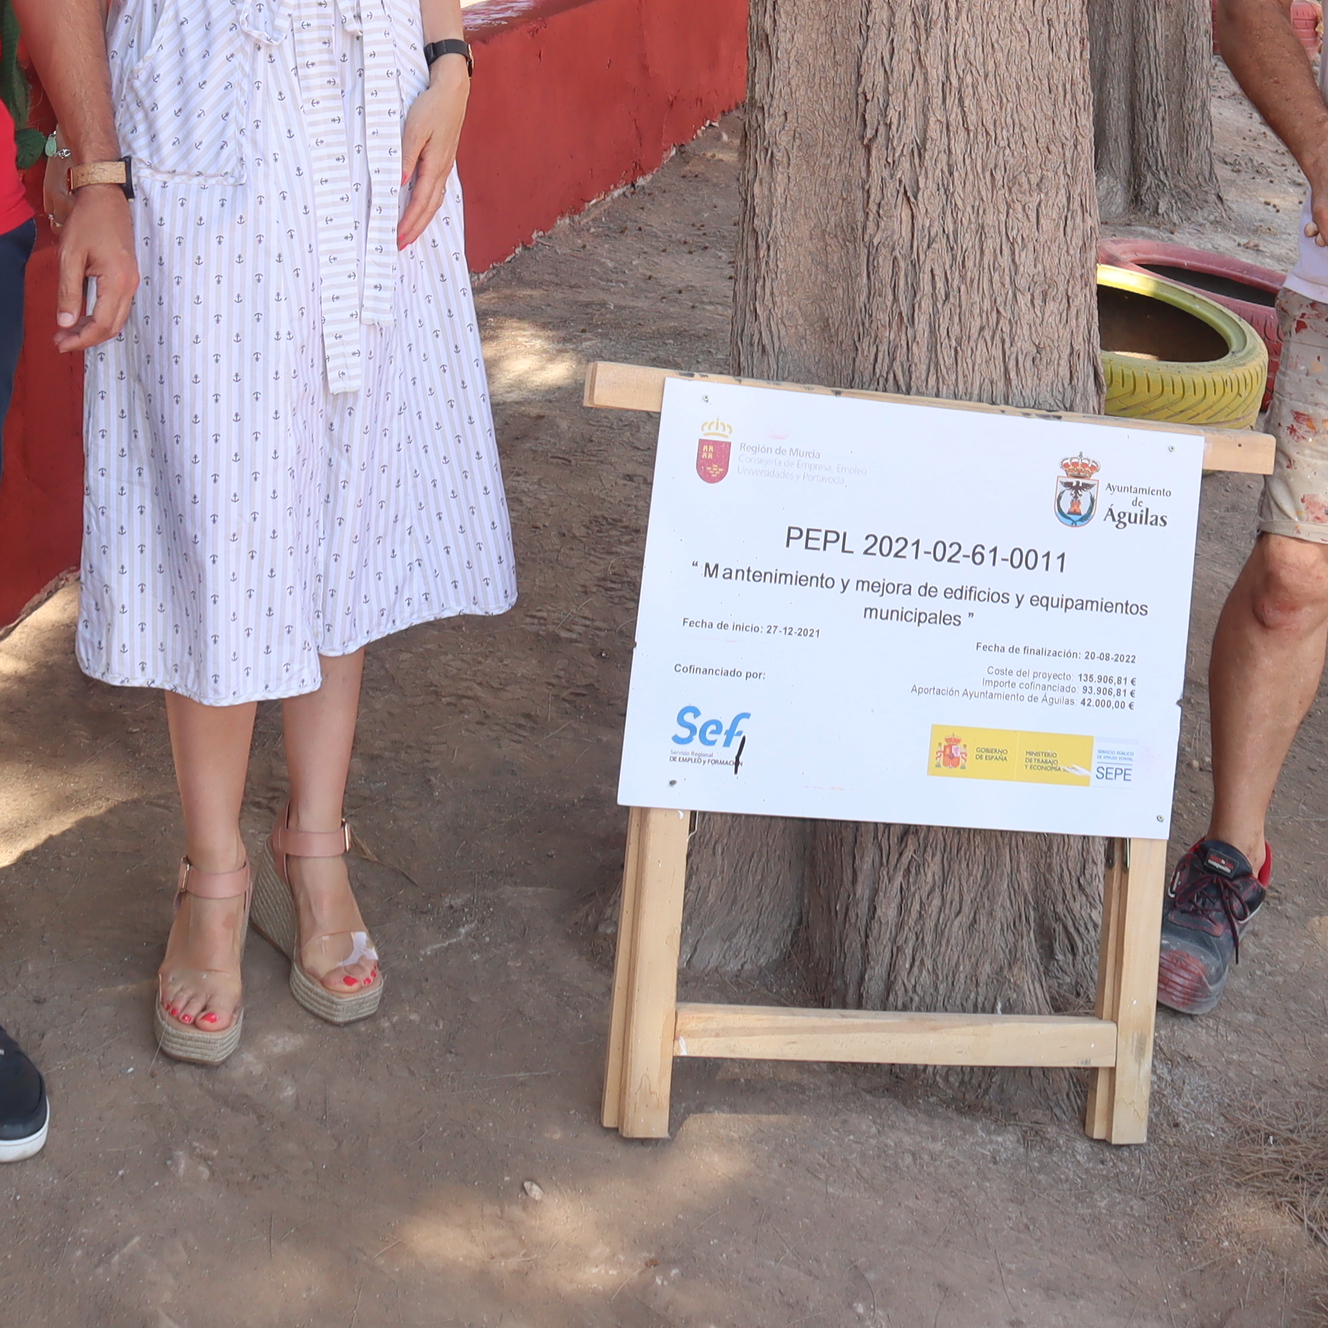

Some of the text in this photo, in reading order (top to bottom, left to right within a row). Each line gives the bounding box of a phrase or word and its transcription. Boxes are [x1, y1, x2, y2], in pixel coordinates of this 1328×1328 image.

[739, 442, 821, 460] Región de Murcia
[737, 465, 794, 480] Universidades
[795, 472, 801, 482] y
[738, 453, 782, 468] Consejería
[784, 458, 795, 468] de
[836, 464, 868, 476] Empleo
[1105, 482, 1172, 498] Ayuntamiento
[1131, 496, 1144, 508] de
[1103, 503, 1168, 530] Águilas
[784, 525, 1068, 574] PEPL 2021-02-61-0011
[839, 577, 851, 594] y
[855, 578, 913, 598] mejora
[917, 582, 939, 599] de
[943, 585, 1011, 605] edificios
[1015, 592, 1025, 610] y
[1029, 594, 1149, 617] equipamientos
[863, 605, 962, 628] municipales
[682, 617, 821, 639] Fecha de inicio: 27-12-2021
[975, 642, 1137, 665] Fecha de finalización: 20-08-2022
[673, 663, 767, 682] Cofinanciado por:
[986, 665, 1137, 687] Coste del proyecto: 135.906,81 €
[910, 684, 1135, 711] Aportación Ayuntamiento de Águilas: 42.000,00 €
[982, 677, 1136, 699] Importe cofinanciado: 93.906,81 €
[671, 705, 752, 748] Sef
[678, 757, 702, 765] EMPLEO
[975, 746, 1009, 756] GOBIERNO
[984, 754, 1008, 762] ESPAÑA
[1025, 750, 1058, 759] MINISTERIO
[1095, 765, 1133, 782] SEPE
